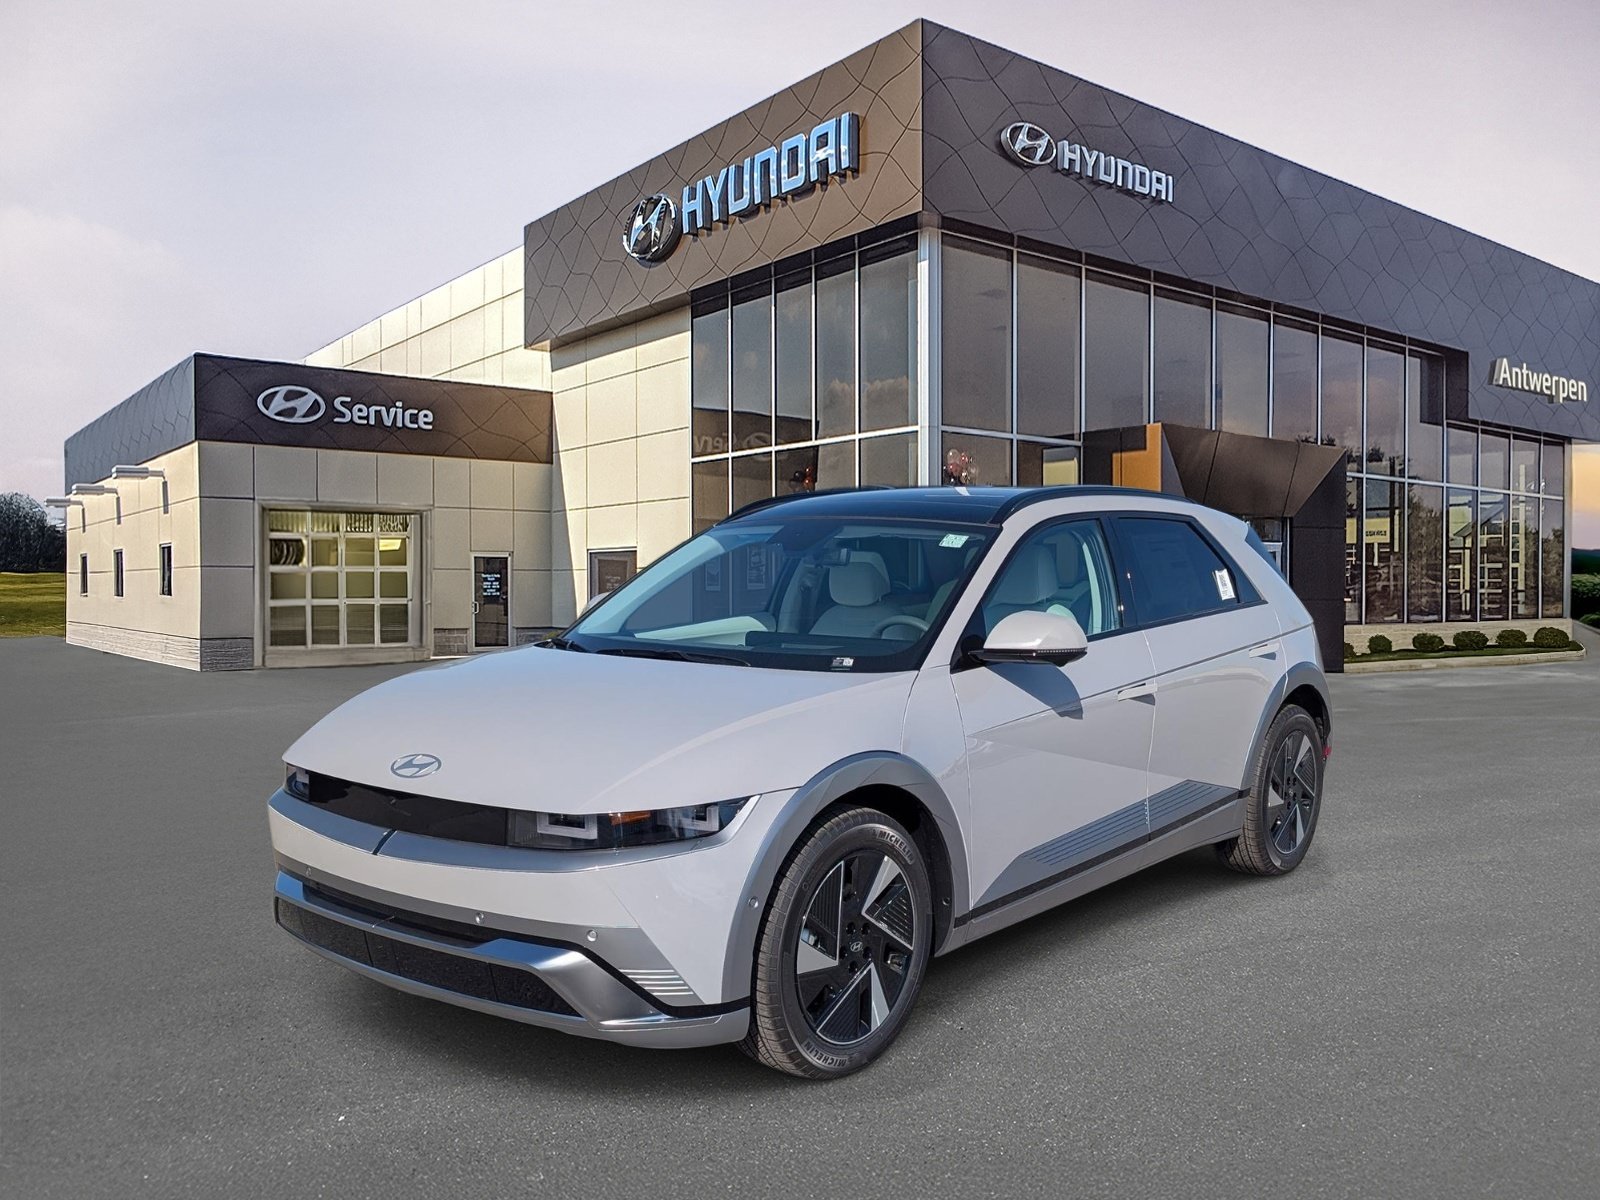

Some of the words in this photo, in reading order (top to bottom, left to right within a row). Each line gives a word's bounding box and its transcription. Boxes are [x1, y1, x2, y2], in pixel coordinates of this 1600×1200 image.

[681, 112, 856, 234] HYUNDAI
[1057, 140, 1174, 202] HYUNDAI
[1495, 358, 1587, 403] Antwerpen
[333, 396, 434, 430] Service
[878, 829, 914, 862] MICHELIN
[803, 1040, 848, 1067] MICHELIN
